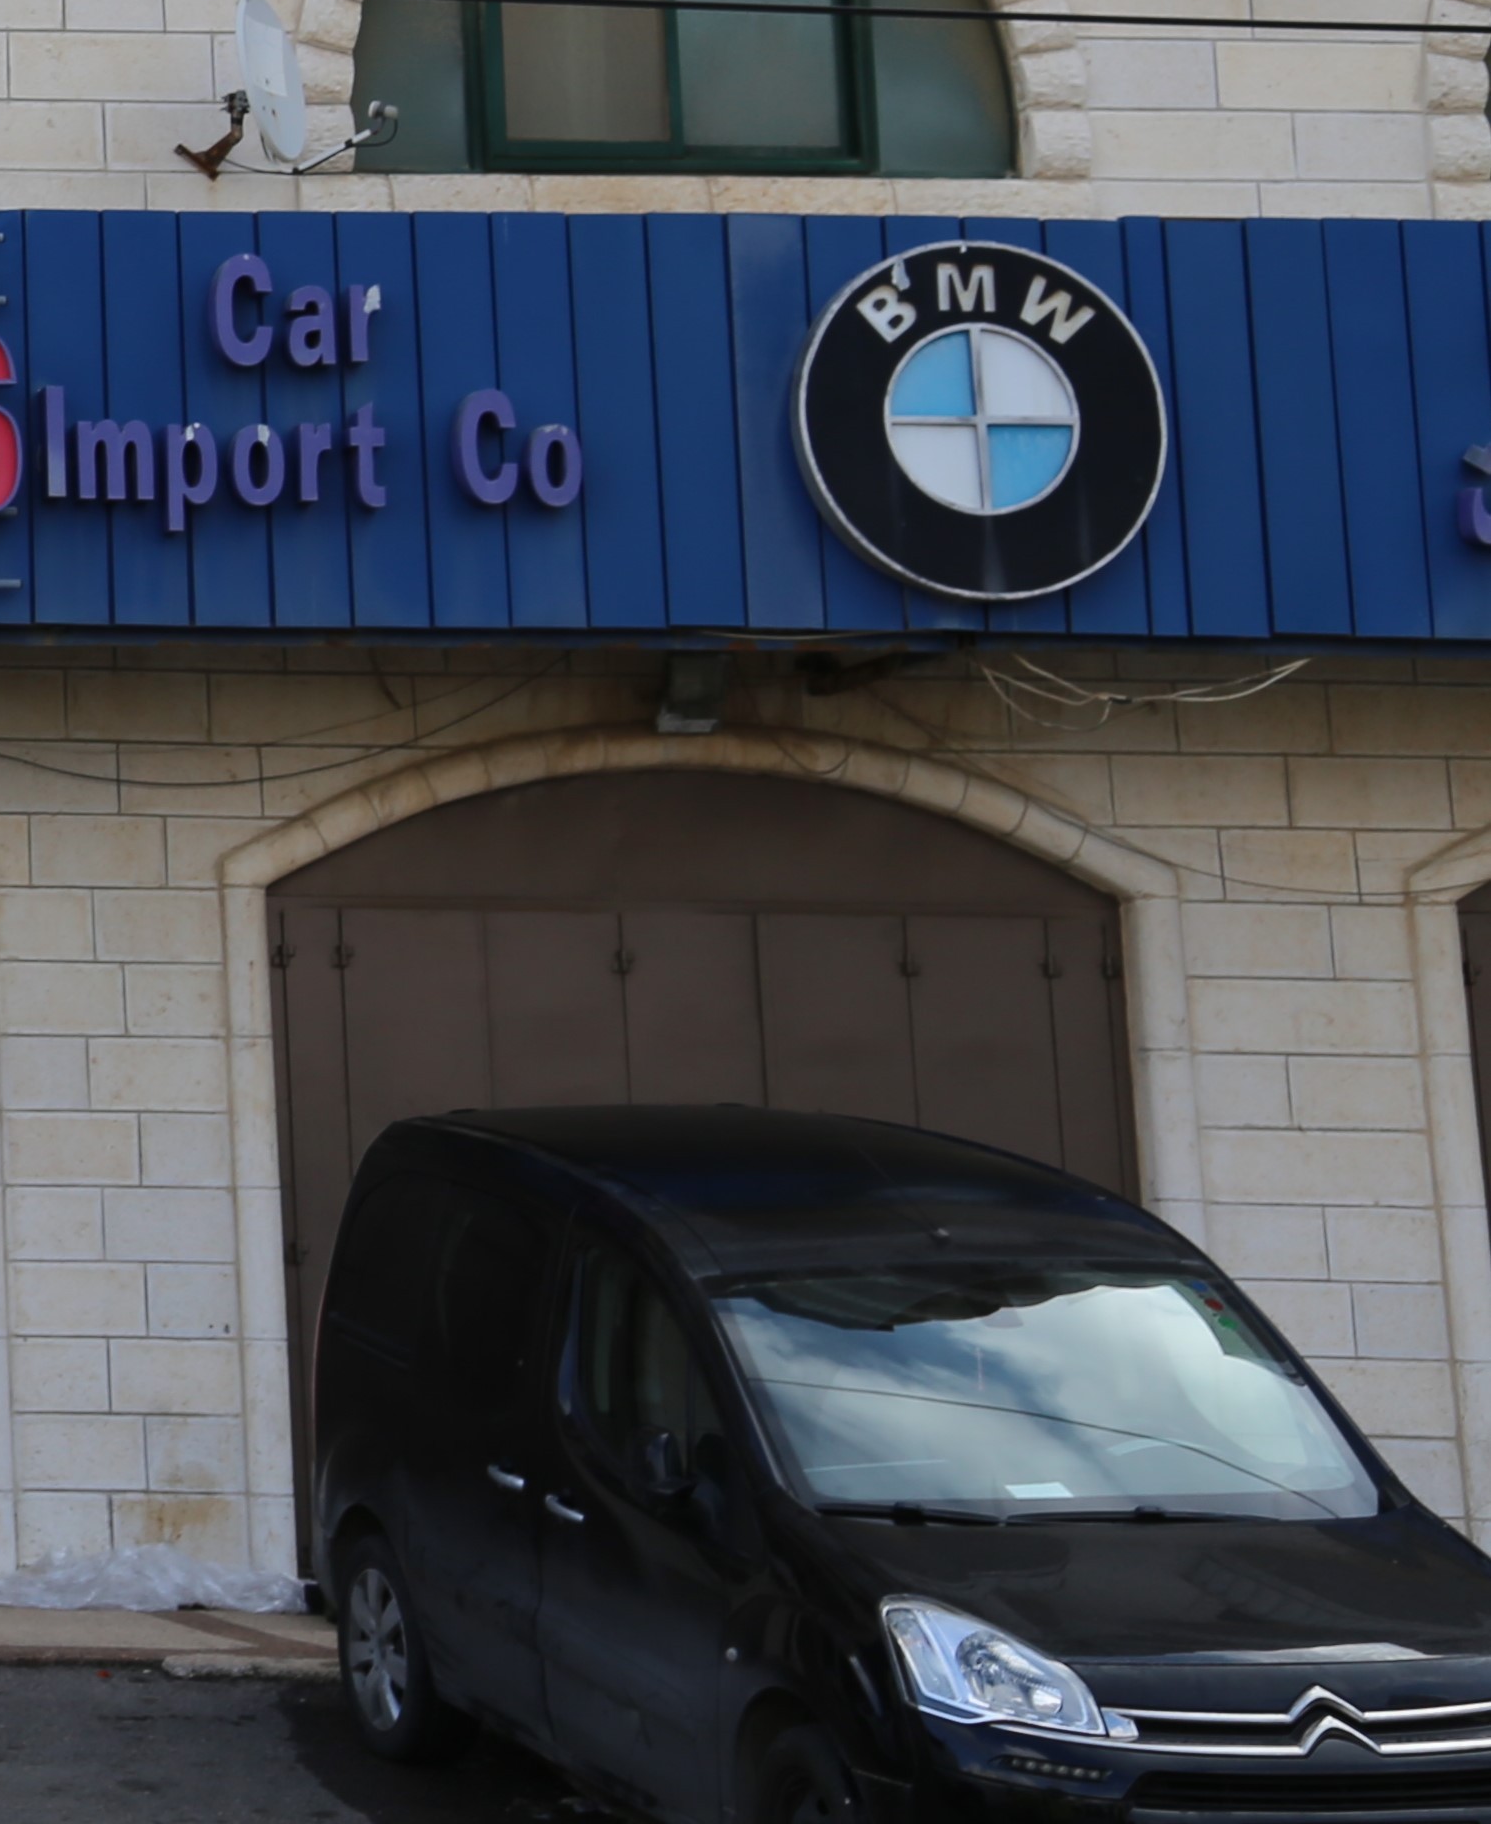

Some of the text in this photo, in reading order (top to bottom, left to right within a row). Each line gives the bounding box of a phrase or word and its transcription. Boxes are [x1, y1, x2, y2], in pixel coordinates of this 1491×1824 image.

[207, 253, 381, 367] Car
[856, 262, 1096, 345] BMW
[37, 384, 583, 533] Import Co
